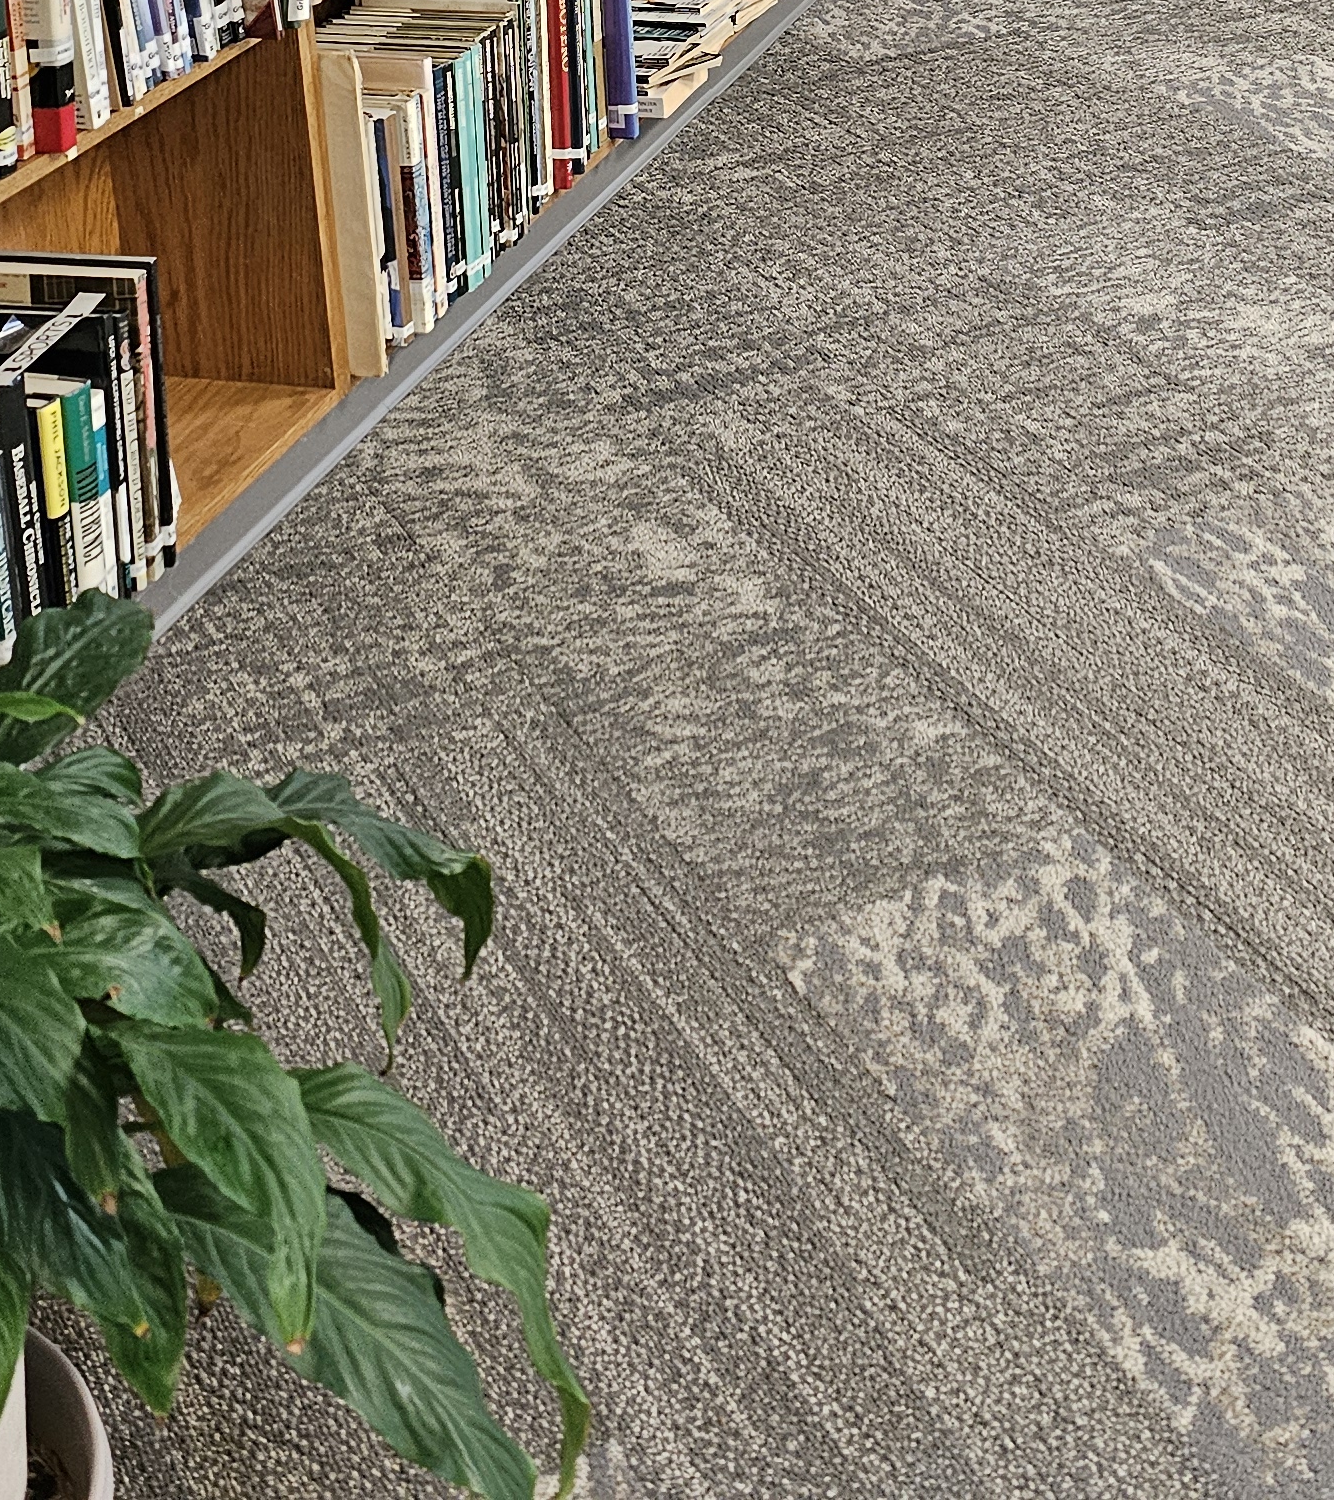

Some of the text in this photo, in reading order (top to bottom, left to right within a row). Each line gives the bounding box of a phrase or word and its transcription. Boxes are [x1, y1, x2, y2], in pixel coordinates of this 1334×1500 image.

[12, 319, 73, 367] SPORTS
[49, 410, 67, 509] PHIL JACKSON
[122, 377, 147, 562] AND THE CROWD GOES WILD
[11, 443, 43, 617] BASEBALL CHRONICL
[75, 460, 104, 567] INTERFERENCE
